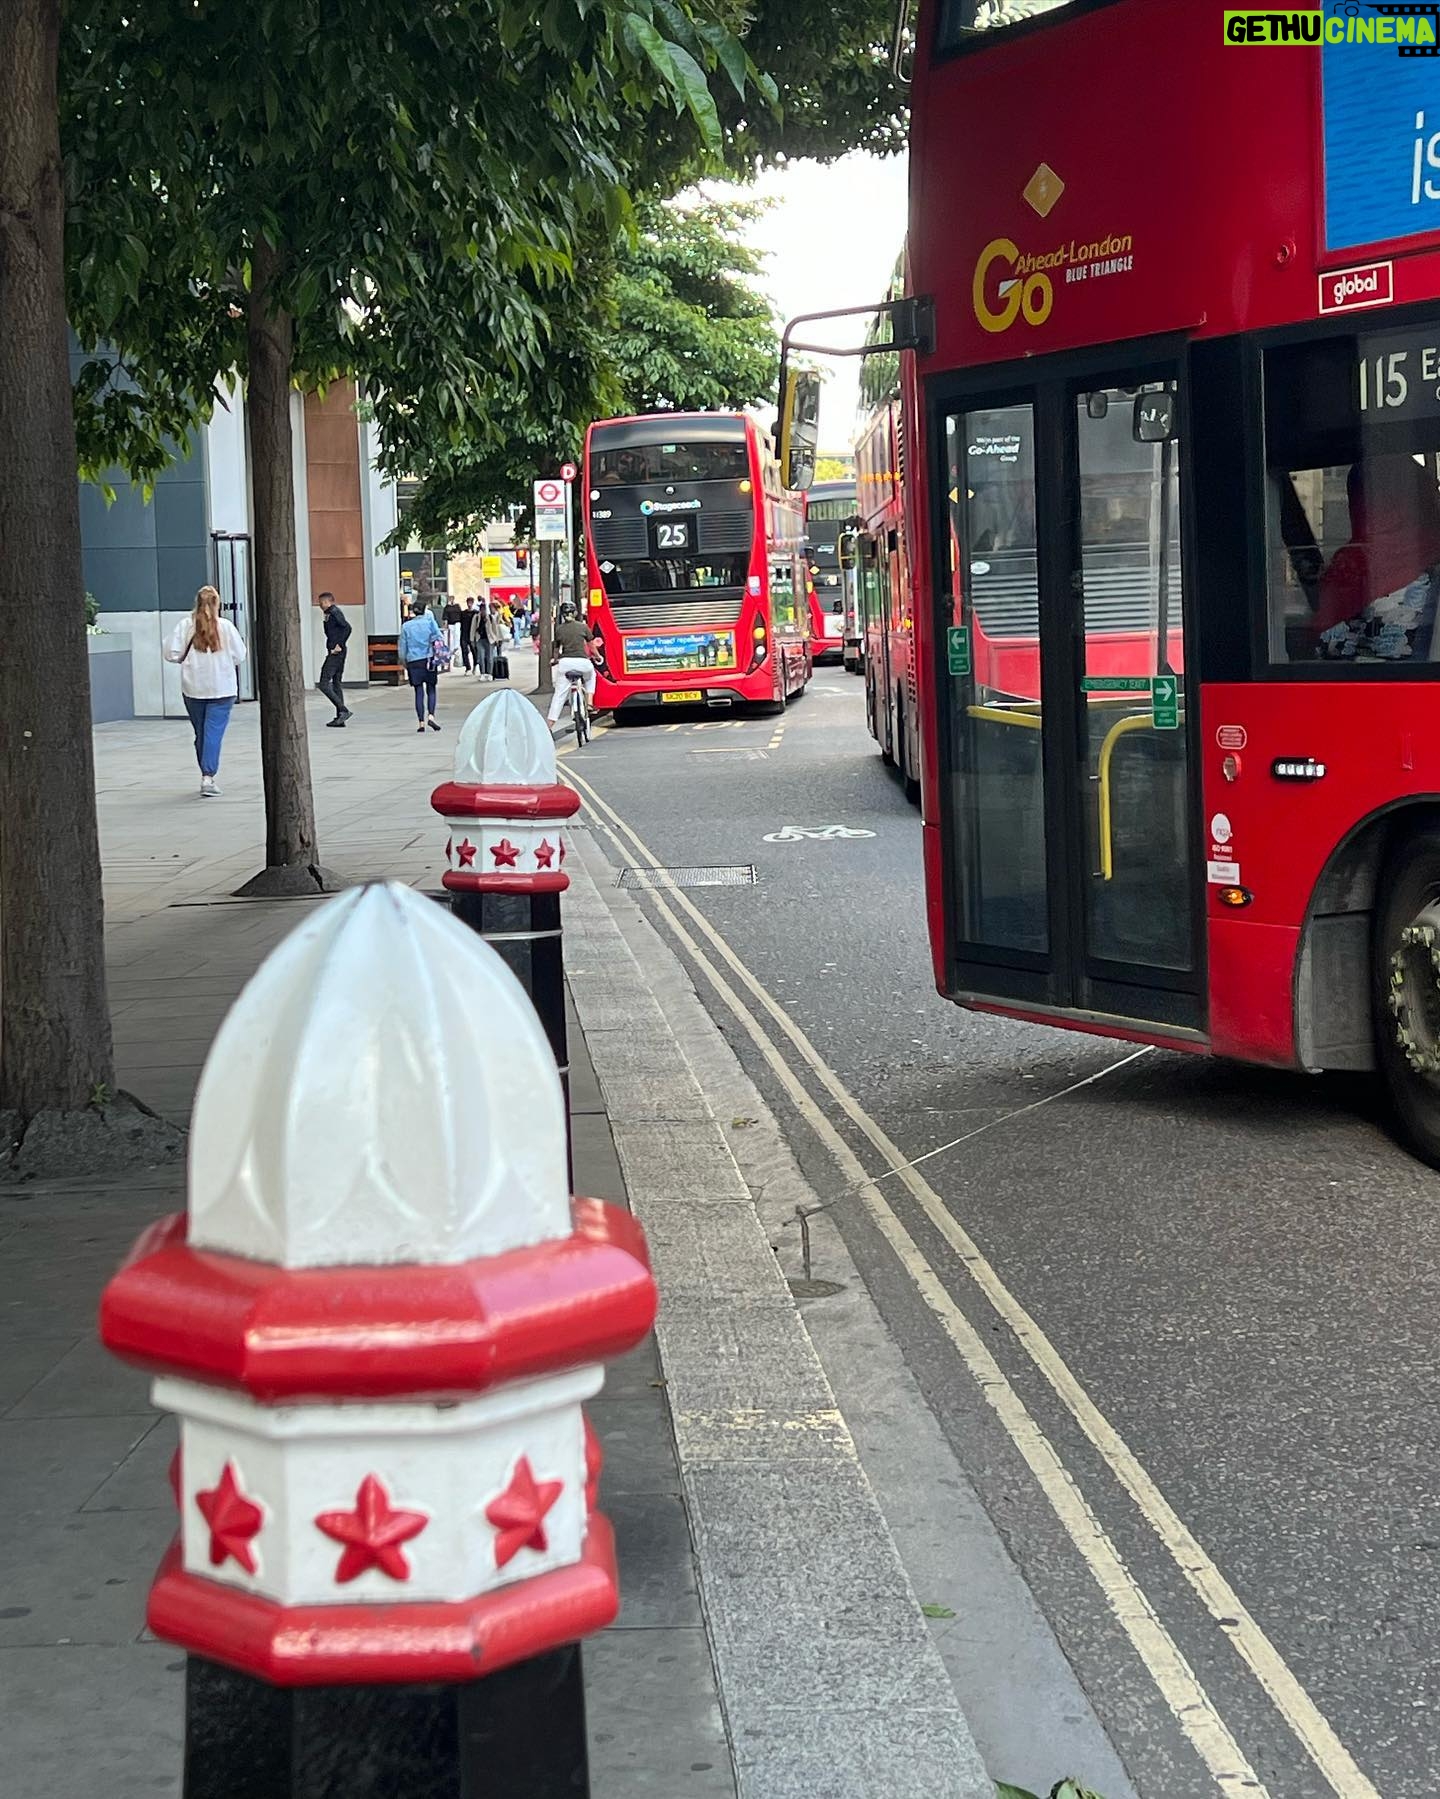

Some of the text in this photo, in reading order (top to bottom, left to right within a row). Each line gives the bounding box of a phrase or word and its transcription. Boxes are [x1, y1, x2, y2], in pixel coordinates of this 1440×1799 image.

[1066, 255, 1133, 283] BLUE TRIANGLE
[973, 233, 1132, 332] Go Ahead-London
[1334, 270, 1377, 304] global
[1359, 347, 1440, 411] 115 E
[968, 443, 1019, 455] Go-Ahead
[563, 466, 575, 479] D
[653, 499, 701, 512] Stagecoach
[659, 524, 686, 546] 25
